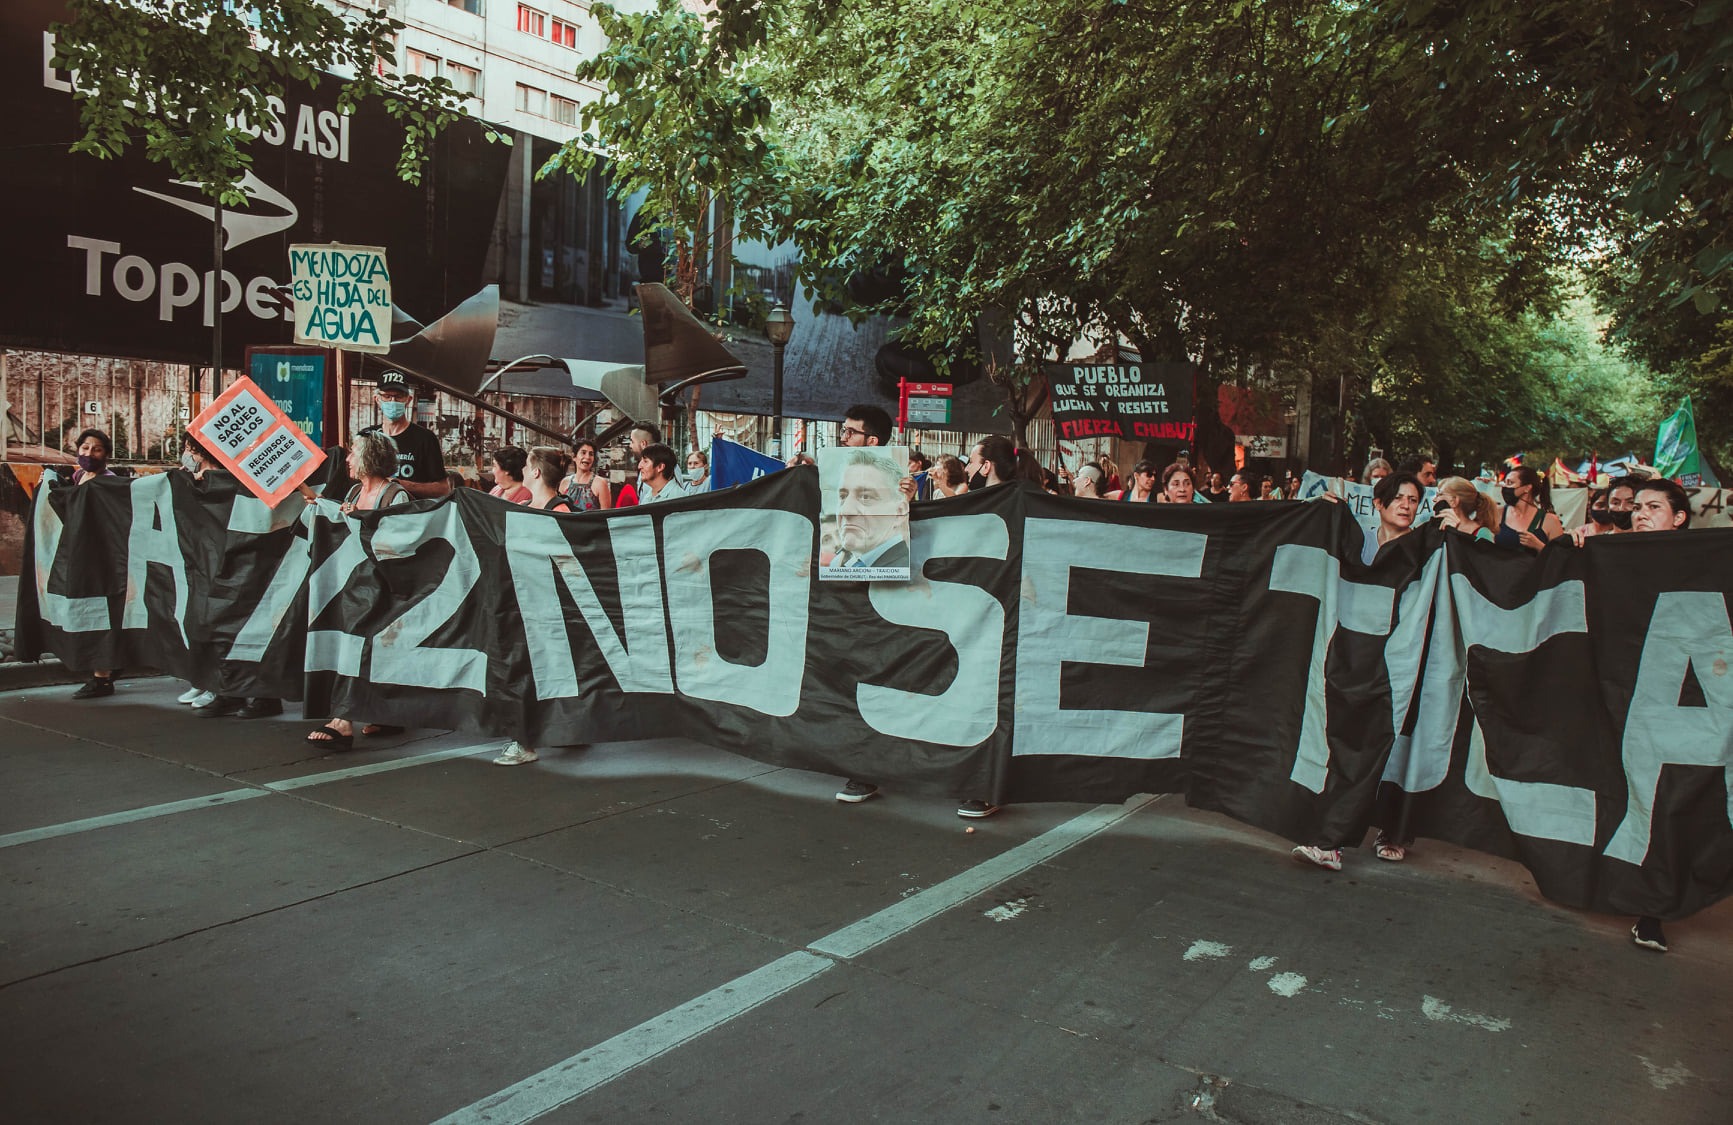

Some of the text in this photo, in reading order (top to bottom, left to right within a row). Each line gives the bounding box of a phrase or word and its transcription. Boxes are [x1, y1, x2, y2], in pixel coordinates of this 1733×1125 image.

[291, 250, 389, 283] MENDOZA
[294, 277, 390, 310] ES HIJA DEL
[304, 305, 380, 344] AGUA
[382, 372, 404, 384] 7722
[1073, 365, 1141, 384] PUEBLO
[1055, 383, 1166, 397] QUE SE ORGANIZA
[90, 402, 97, 412] 6
[182, 408, 188, 417] 7
[214, 403, 245, 431] NO AL
[1052, 399, 1169, 414] LUCHA Y RESISTE
[217, 406, 258, 443] SAQUEO
[229, 416, 264, 448] DE LOS
[1061, 418, 1197, 442] FUERZA CHUBUT
[248, 434, 287, 469] RECURSOS
[253, 439, 295, 477] NATURALES
[33, 470, 190, 650] LA
[505, 508, 815, 717] NO
[856, 512, 1207, 762] SE
